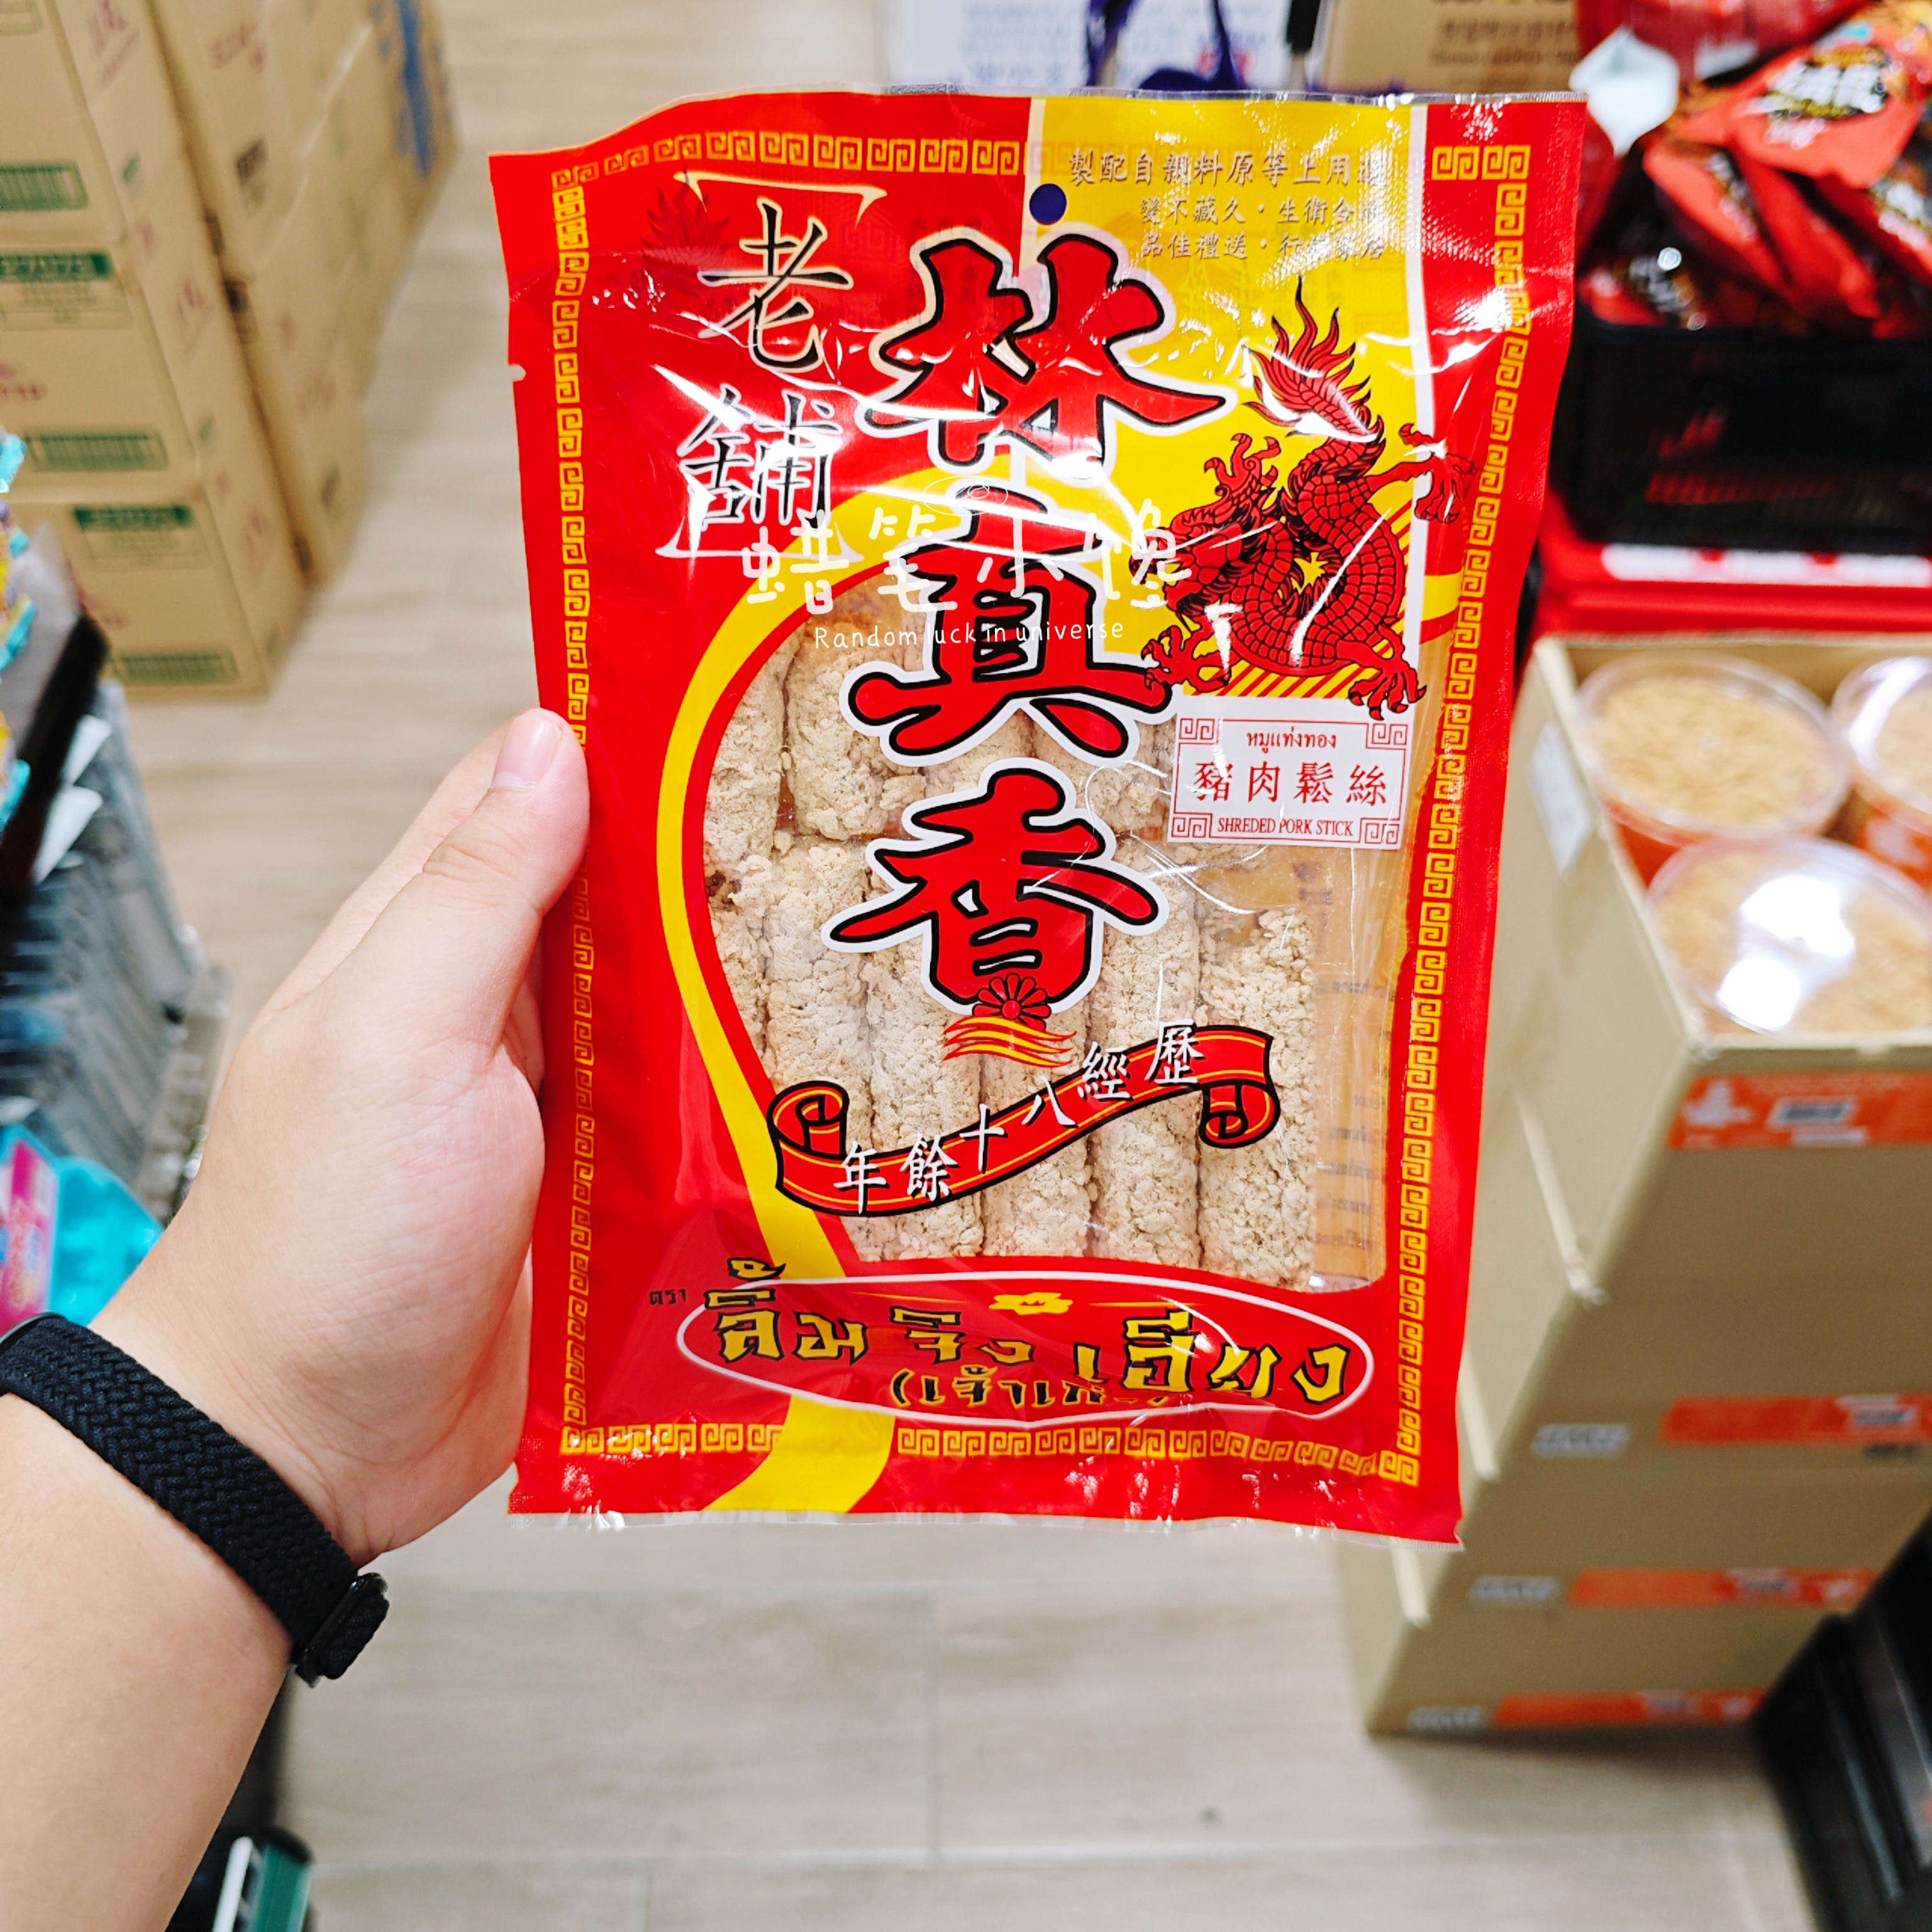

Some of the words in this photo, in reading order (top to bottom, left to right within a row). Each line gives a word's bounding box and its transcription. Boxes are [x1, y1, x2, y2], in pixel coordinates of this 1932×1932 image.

[1246, 726, 1337, 754] หมูแท่งทอง
[1217, 817, 1276, 835] SHREDED
[1278, 819, 1313, 836] PORK
[1315, 820, 1354, 837] STICK
[648, 1288, 687, 1306] ตรา
